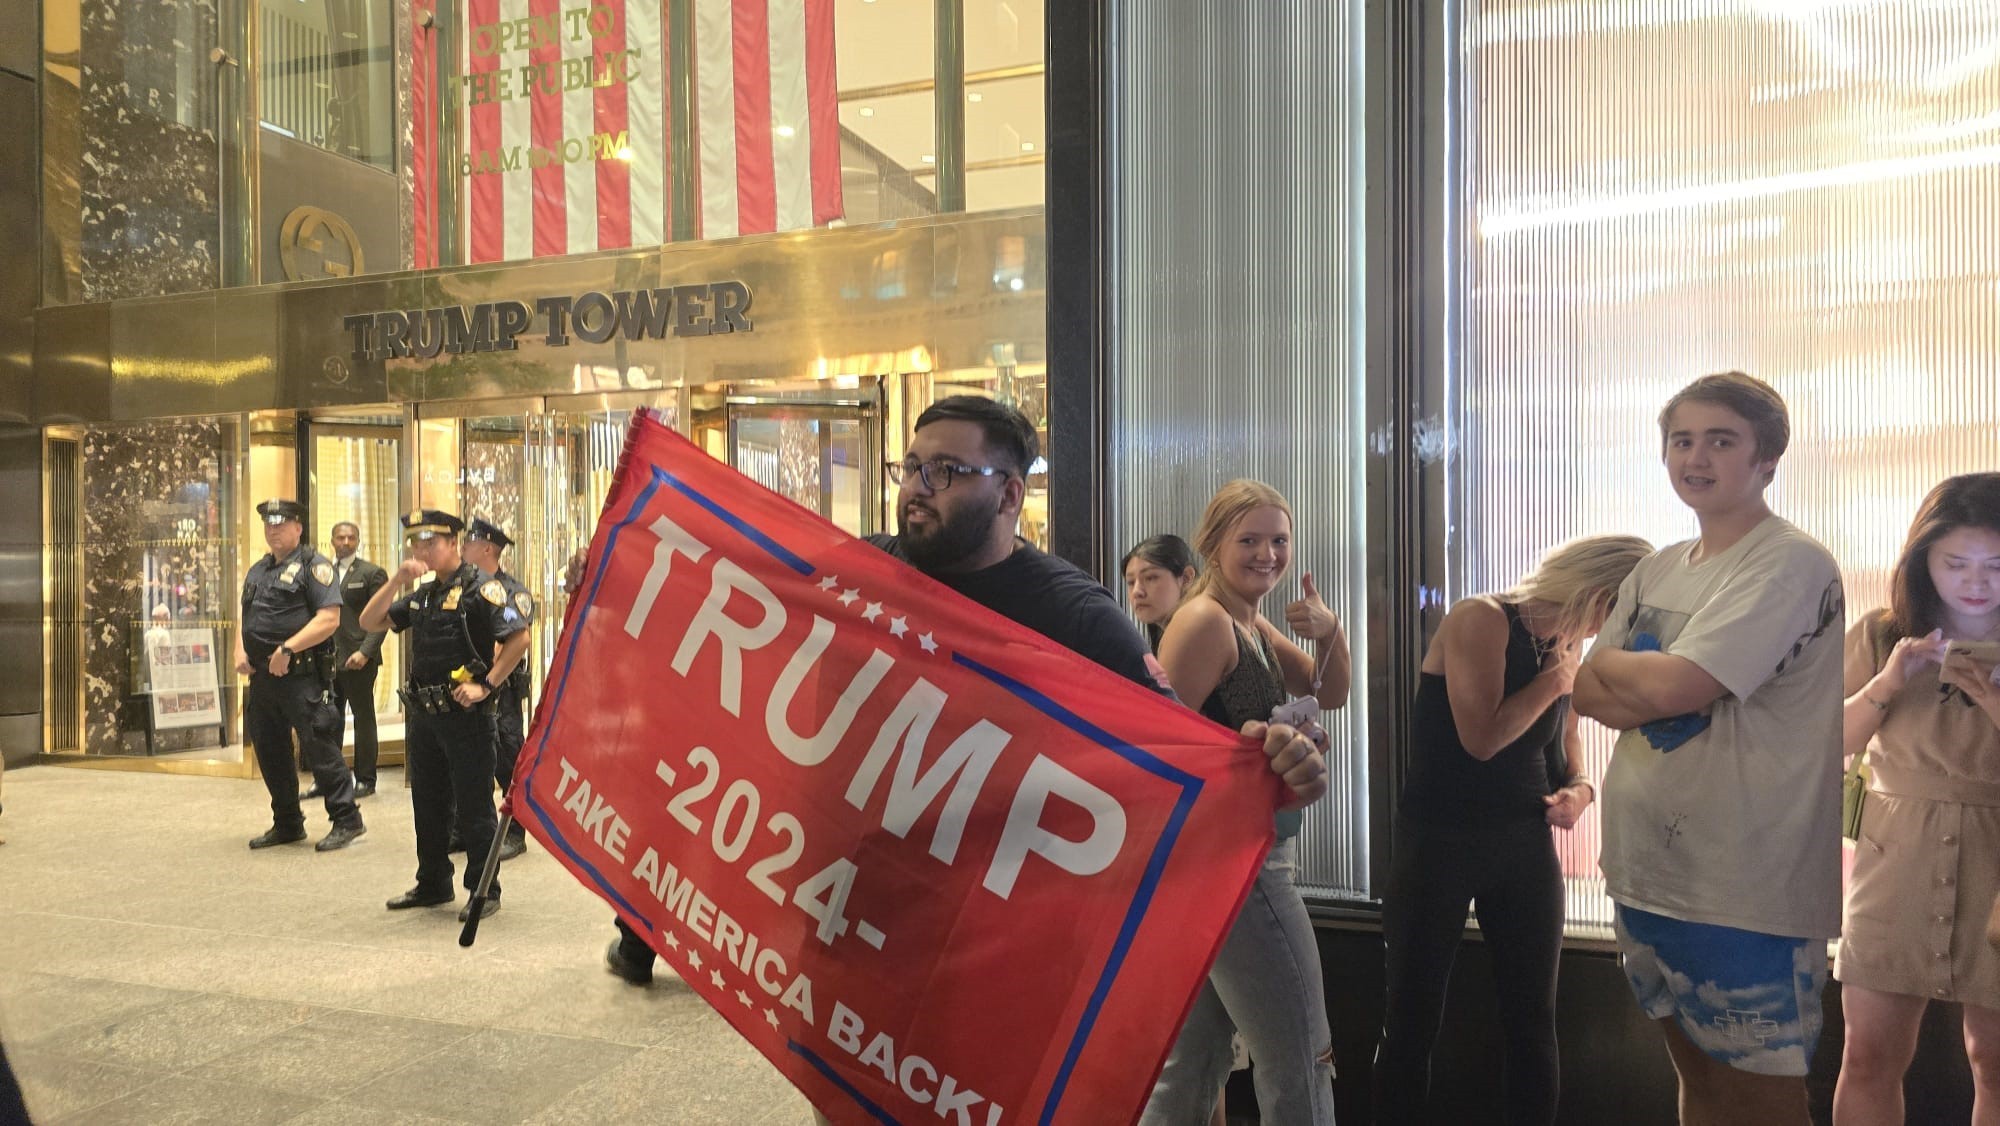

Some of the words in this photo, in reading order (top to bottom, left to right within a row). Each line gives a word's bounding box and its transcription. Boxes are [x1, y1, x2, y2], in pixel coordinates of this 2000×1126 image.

[470, 13, 561, 57] OPEN
[566, 5, 615, 42] TO
[448, 70, 513, 109] THE
[519, 48, 642, 98] PUBLIC
[587, 130, 629, 161] PM
[343, 299, 534, 361] TRUMP
[537, 280, 754, 347] TOWER
[623, 514, 1128, 901] TRUMP
[655, 745, 887, 952] -2024-
[553, 755, 632, 865] TAKE
[631, 845, 815, 1027] AMERICA
